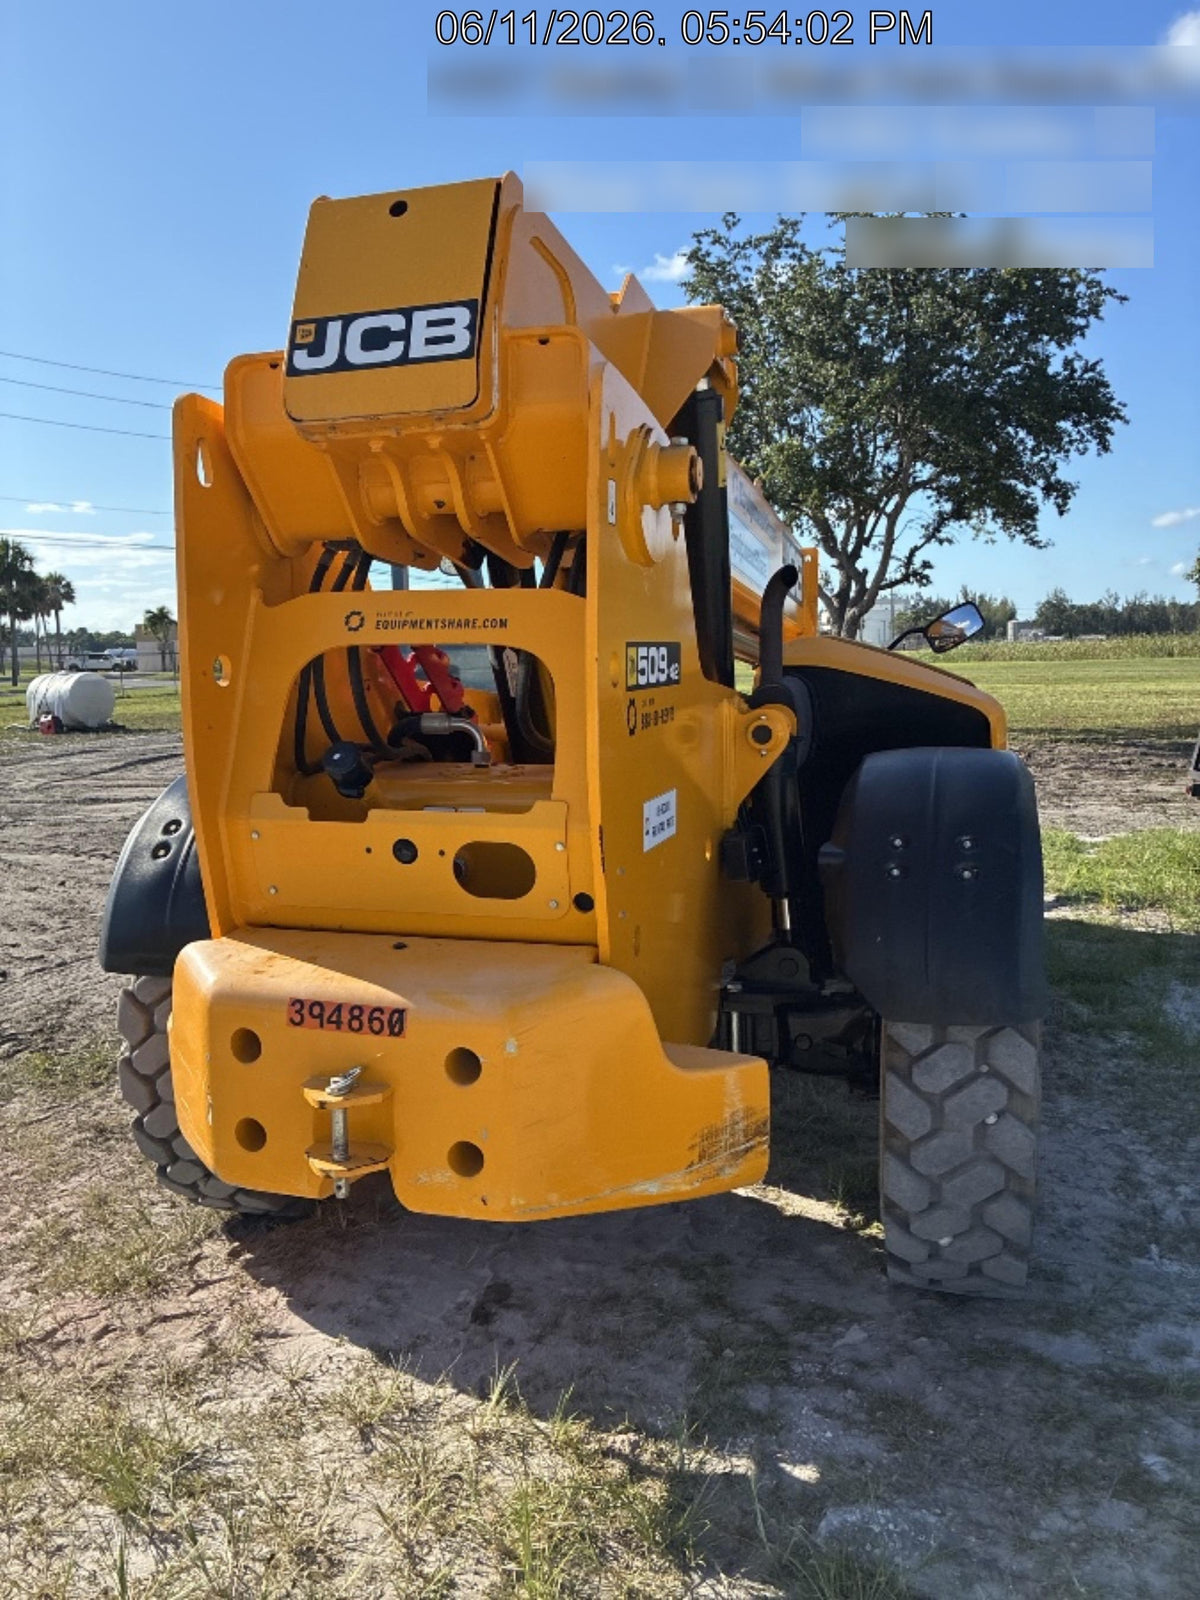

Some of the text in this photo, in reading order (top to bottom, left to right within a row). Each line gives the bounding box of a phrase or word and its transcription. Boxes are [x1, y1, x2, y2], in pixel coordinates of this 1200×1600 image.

[292, 306, 472, 371] JCB
[375, 618, 509, 630] EQUIPMENTSHARE.COM
[289, 999, 406, 1037] 394860
